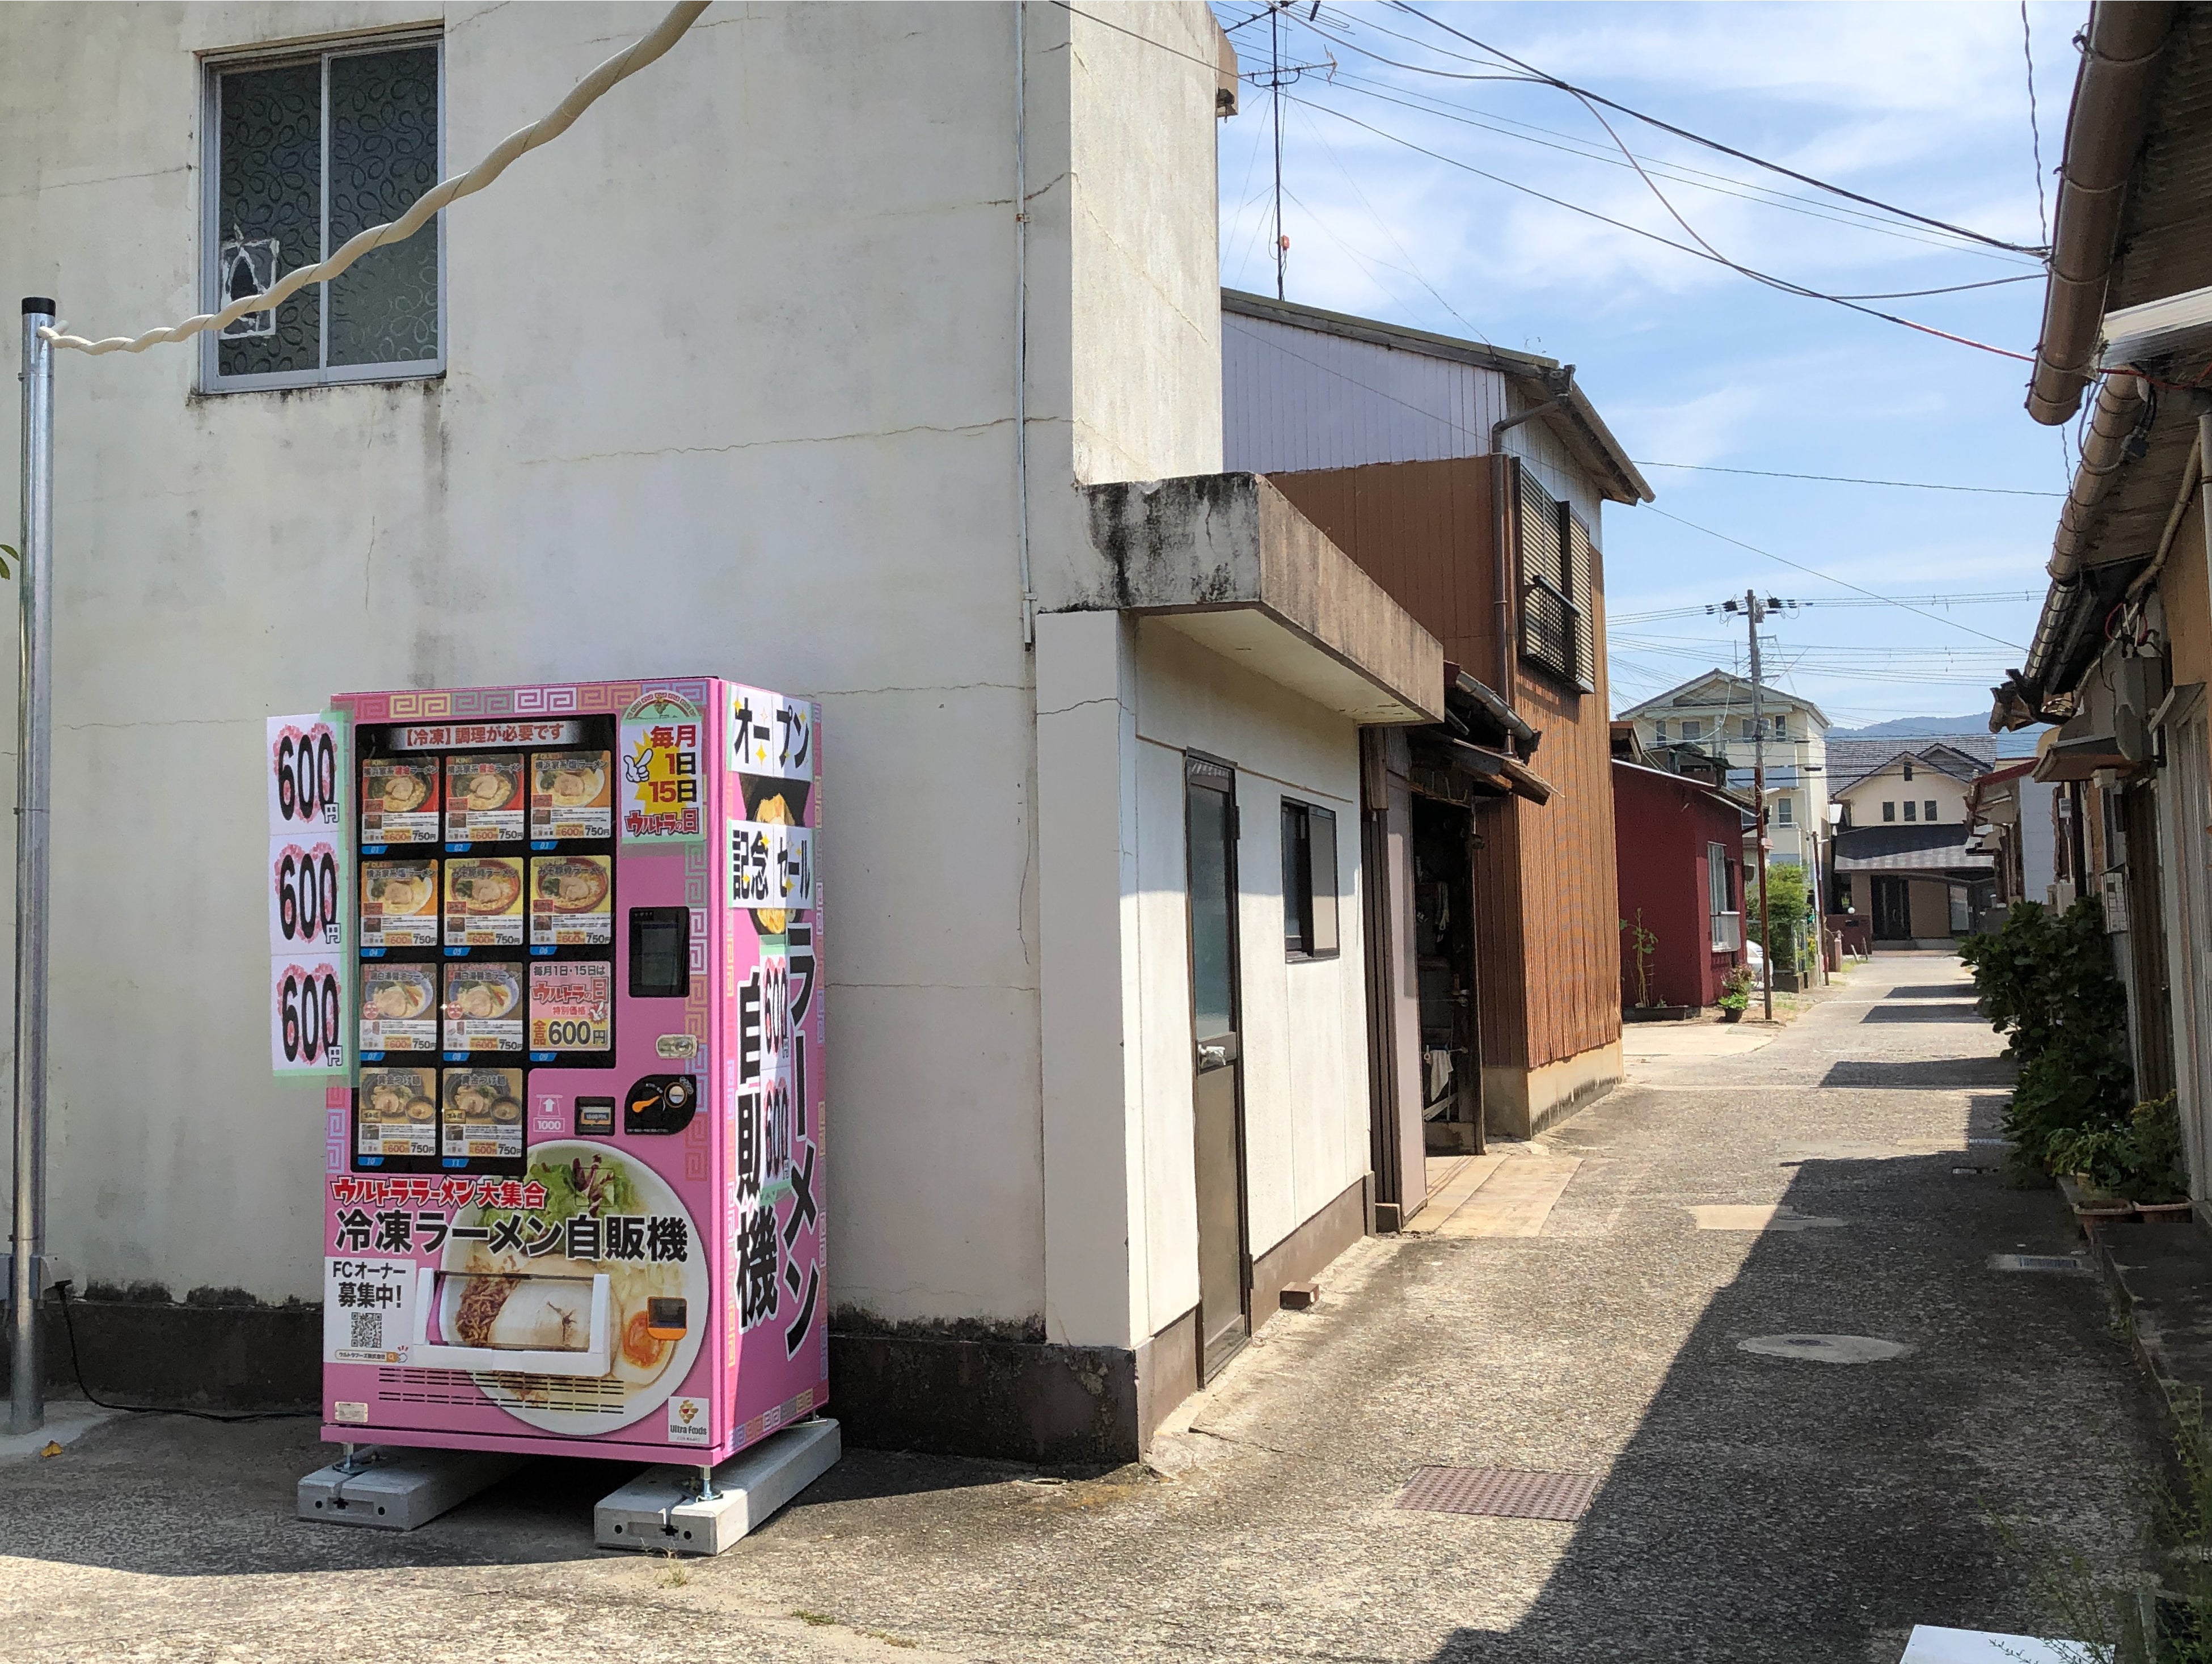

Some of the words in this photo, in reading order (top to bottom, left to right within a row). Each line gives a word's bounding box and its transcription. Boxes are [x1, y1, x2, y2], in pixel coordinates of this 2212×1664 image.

[651, 724, 696, 748] 毎月
[734, 697, 809, 768] オープン
[665, 752, 696, 775] 1日
[278, 733, 339, 823] 600円
[648, 779, 696, 803] 15日
[585, 827, 610, 836] 750円
[624, 808, 699, 837] ウルトラの日
[413, 831, 436, 841] 750円
[499, 830, 523, 839] 750円
[280, 852, 340, 944] 600円
[413, 935, 436, 944] 750円
[496, 935, 520, 944] 750円
[586, 934, 610, 944] 750円
[534, 965, 606, 976] 毎月1日・15日は
[531, 977, 609, 1004] ウルトラの日
[282, 974, 343, 1066] 600円
[552, 1006, 586, 1015] 特別価格
[765, 967, 789, 1059] 600円
[533, 1020, 546, 1045] 全品
[548, 1020, 607, 1045] 600円
[413, 1040, 436, 1049] 750円
[499, 1041, 522, 1050] 750円
[537, 1120, 562, 1130] 1000
[766, 1087, 790, 1180] 600円
[411, 1144, 435, 1154] 750円
[498, 1145, 522, 1155] 750円
[783, 924, 820, 1358] ラーメン
[331, 1176, 547, 1209] ウルトララーメン大集合
[335, 1208, 689, 1262] 冷凍ラーメン自販機
[338, 1281, 402, 1310] 募集中!
[670, 1424, 687, 1434] Ultra
